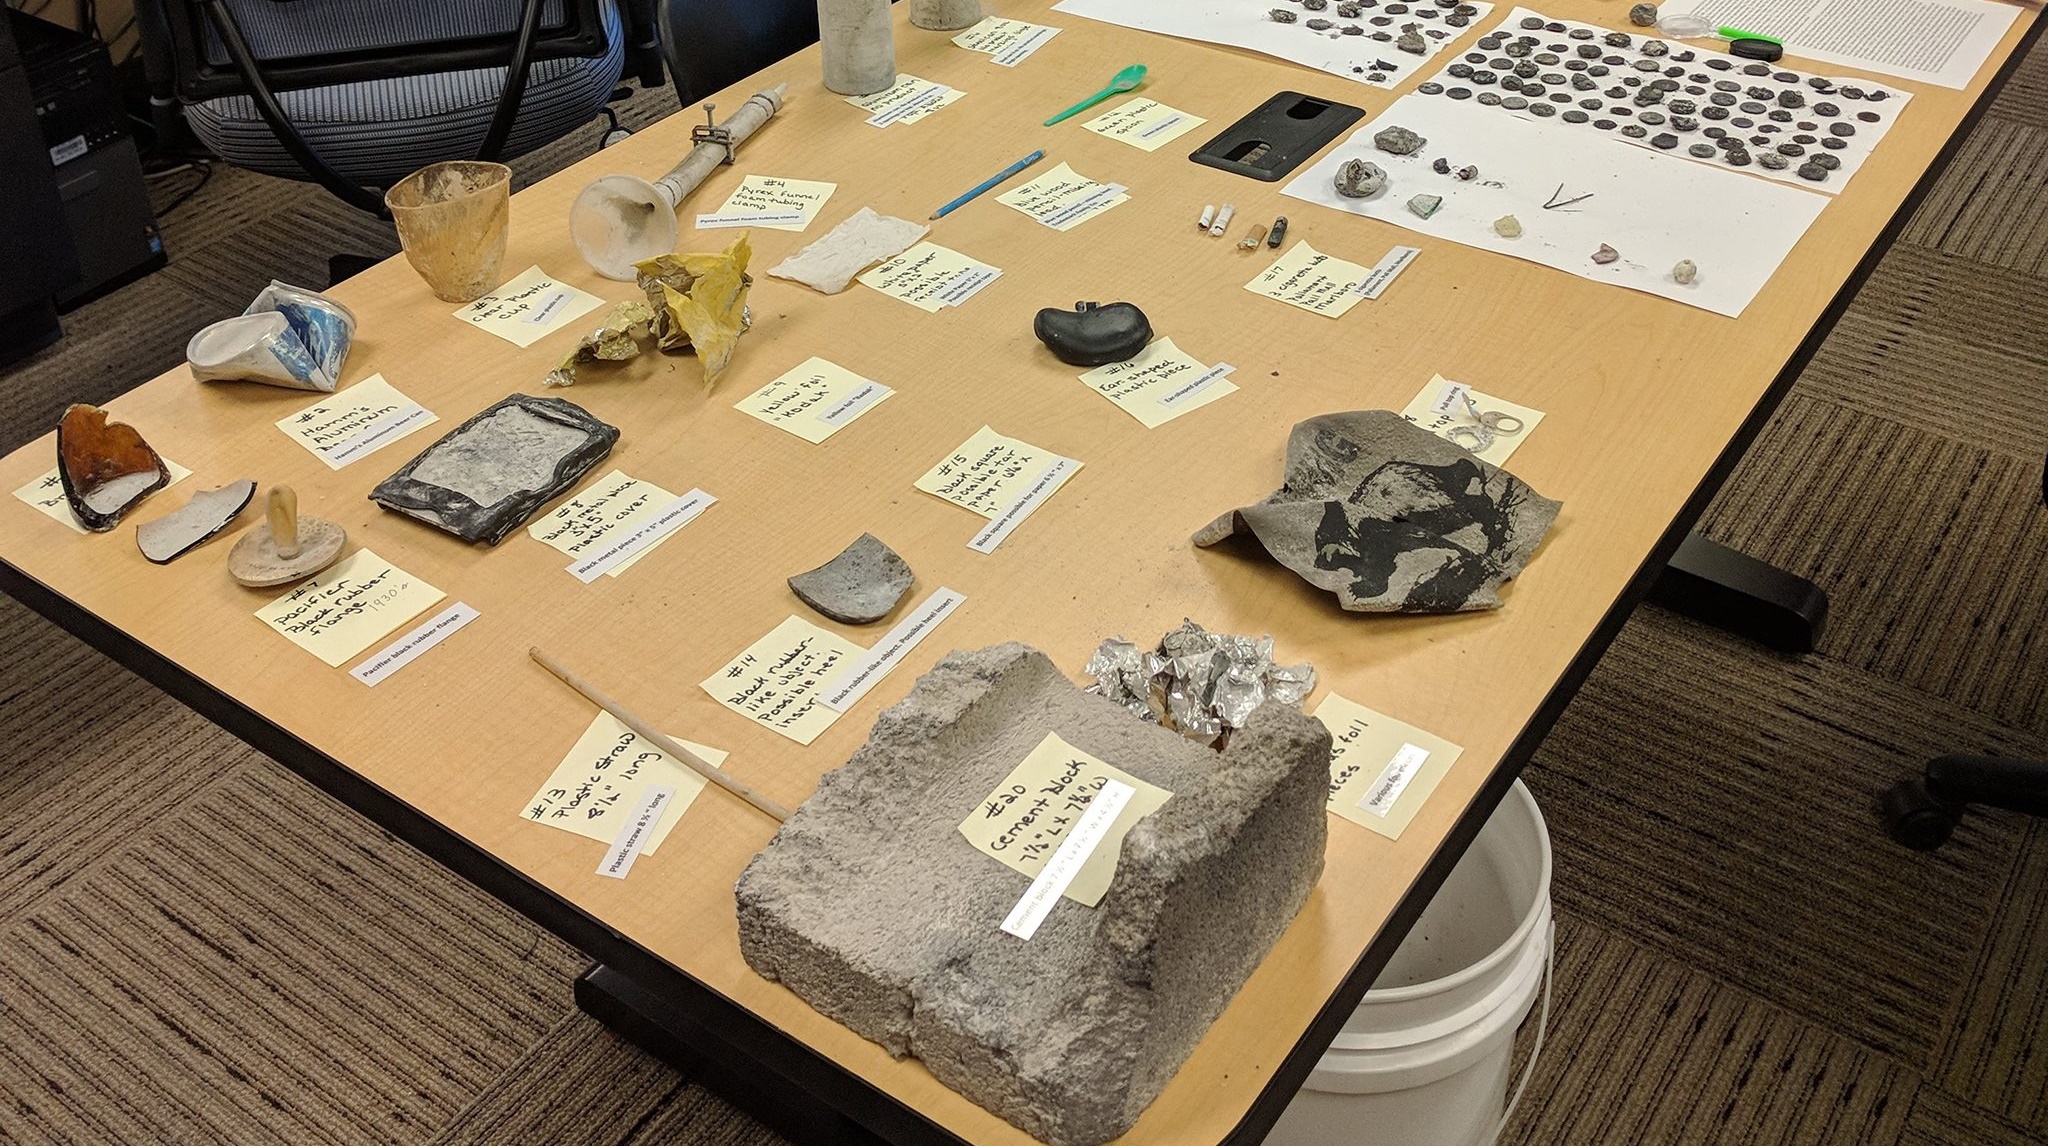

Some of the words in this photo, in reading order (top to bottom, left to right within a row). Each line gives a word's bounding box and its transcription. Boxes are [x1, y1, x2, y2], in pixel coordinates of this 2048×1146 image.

[741, 186, 774, 196] Pyrex
[764, 180, 785, 188] #4
[732, 200, 766, 211] clamp
[470, 296, 499, 312] #3
[296, 408, 331, 424] #2
[301, 406, 370, 437] Hamm's
[313, 405, 398, 444] Aluminum
[362, 424, 396, 446] Aluminum
[938, 454, 967, 476] #15
[971, 446, 1005, 472] square
[968, 480, 1002, 508] paper
[578, 560, 598, 574] Black
[598, 548, 619, 563] metal
[617, 538, 637, 551] piece
[658, 508, 682, 526] plastic
[680, 499, 699, 512] cover
[976, 533, 992, 548] Black
[284, 581, 319, 604] #7
[336, 568, 392, 606] rubber
[362, 655, 392, 678] Pacifier
[391, 643, 414, 659] black
[412, 626, 438, 647] rubber
[436, 612, 460, 632] flange
[830, 687, 852, 706] Black
[848, 659, 883, 691] rubber-like
[880, 643, 902, 664] object.
[900, 620, 926, 644] Possible
[921, 611, 940, 628] heel
[934, 598, 954, 616] insert
[726, 654, 759, 678] #14
[810, 650, 844, 678] heel
[745, 690, 777, 712] like
[1338, 719, 1369, 744] foil
[594, 732, 636, 770] straw
[619, 751, 663, 780] long
[530, 788, 568, 820] #13
[986, 784, 1027, 820] #20
[1370, 780, 1393, 806] Various
[609, 848, 630, 874] Plastic
[626, 827, 642, 850] straw
[648, 792, 666, 809] long
[1011, 901, 1039, 931] Cement
